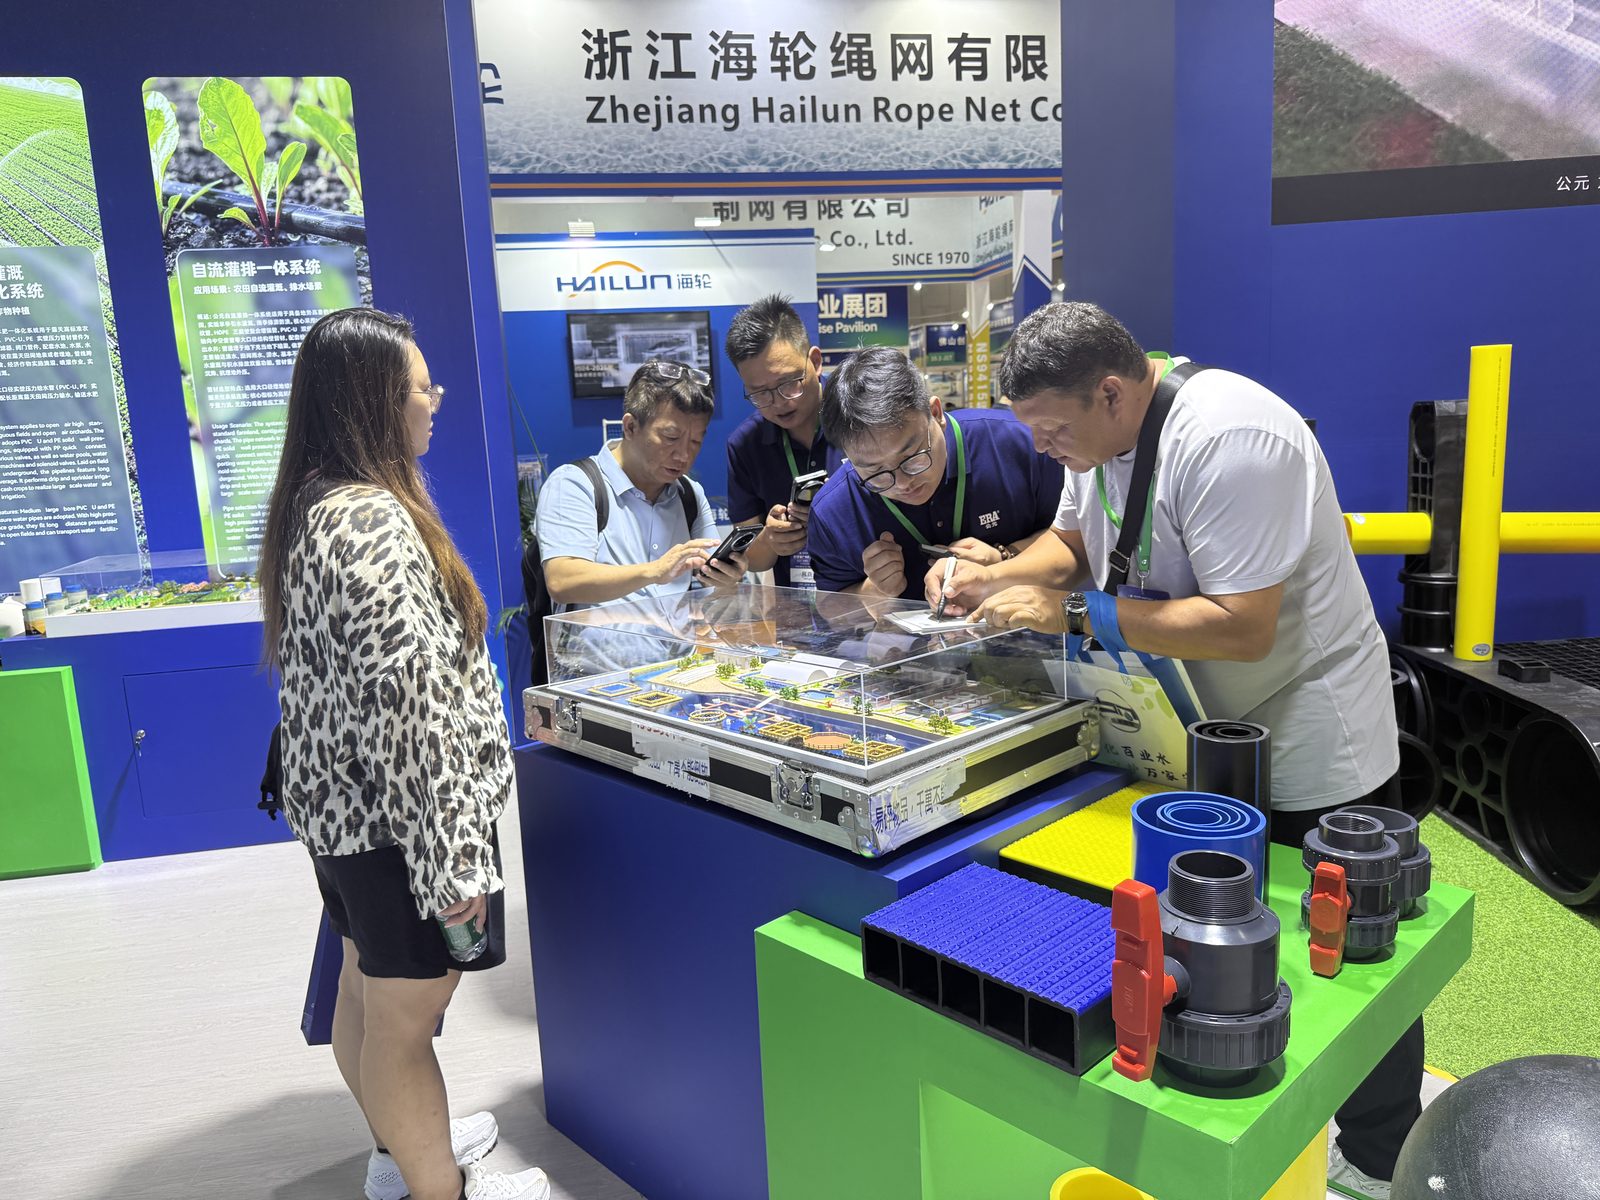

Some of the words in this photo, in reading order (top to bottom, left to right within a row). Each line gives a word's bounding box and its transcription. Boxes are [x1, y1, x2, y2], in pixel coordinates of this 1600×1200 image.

[581, 28, 1049, 82] 浙江海轮绳网有限
[586, 96, 740, 132] Zhejiang
[753, 96, 863, 124] Hailun
[873, 97, 953, 130] Rope
[965, 96, 1021, 122] Net
[1556, 175, 1590, 191] 公元
[713, 197, 910, 222] 制网有限公司
[830, 230, 868, 249] Co.,
[875, 229, 914, 247] Ltd.
[191, 258, 322, 278] 自流灌排一体系统
[892, 253, 933, 266] SINCE
[937, 251, 970, 265] 1970
[557, 273, 672, 293] HAILUN
[676, 273, 712, 291] 海轮
[818, 292, 888, 319] 业展团
[835, 321, 878, 334] Pavilion
[978, 510, 1000, 526] ERA
